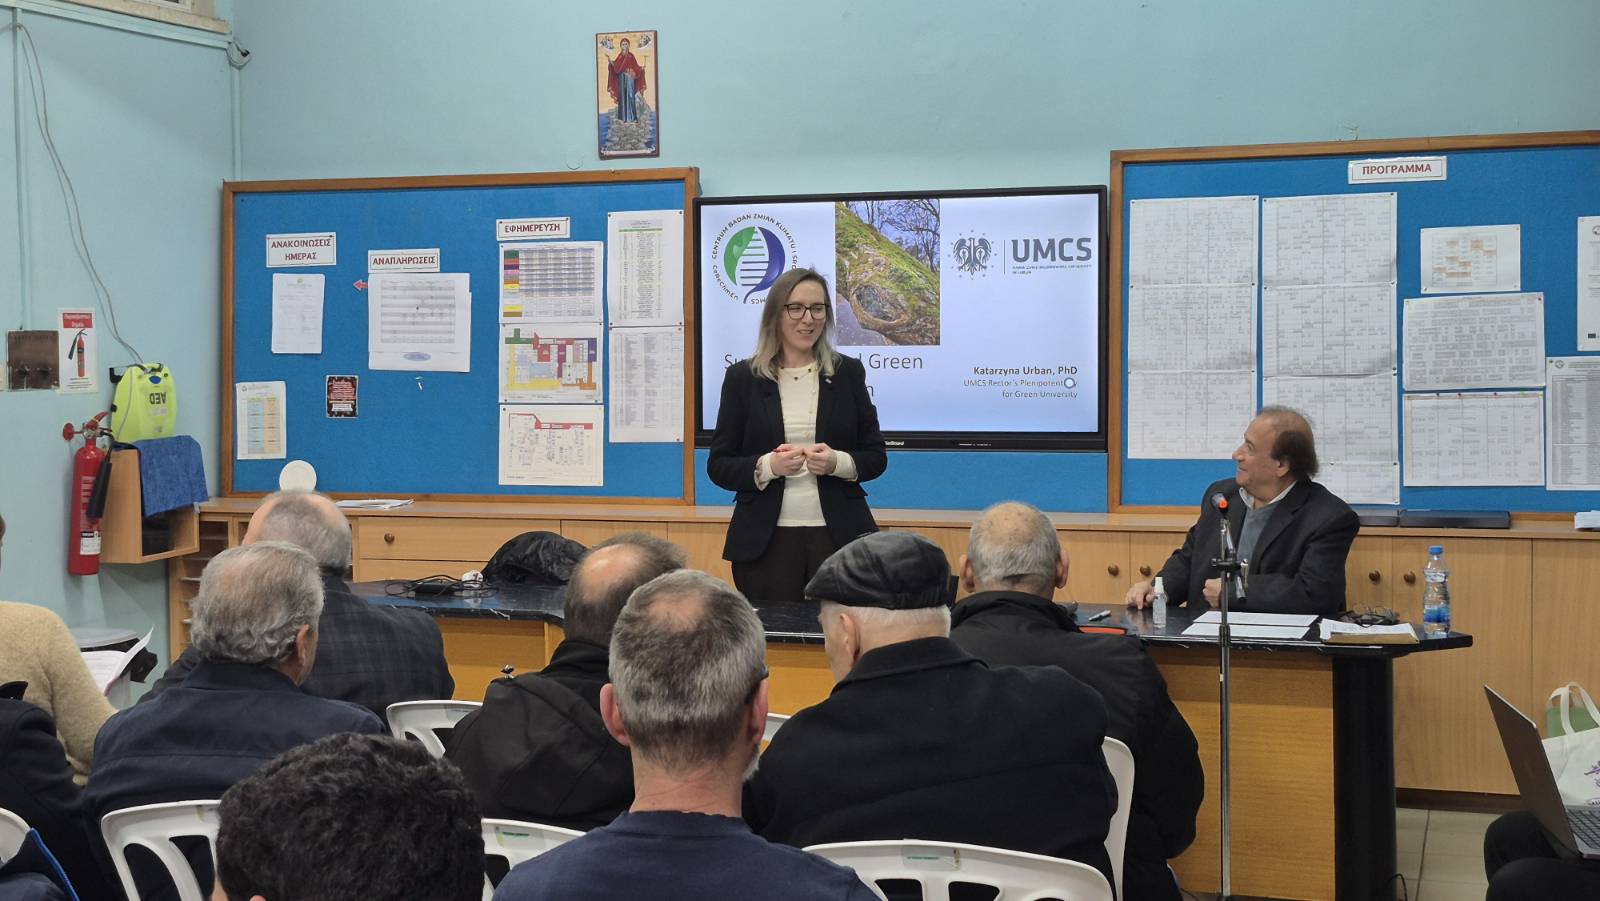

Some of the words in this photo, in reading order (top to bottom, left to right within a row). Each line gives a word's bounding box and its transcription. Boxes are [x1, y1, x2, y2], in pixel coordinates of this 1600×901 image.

[1362, 164, 1432, 175] ΠΡΟΓΡΑΜΜΑ
[504, 223, 560, 233] ΕΦΗΜΕΡΕΥΣΗ
[712, 226, 729, 259] CENTRUM
[753, 213, 775, 224] ZMIAN
[775, 222, 796, 249] KLIMATU
[271, 238, 332, 249] ΑΝΑΚΟΙΝΩΣΕΙΣ
[1011, 238, 1092, 263] UMCS
[285, 252, 316, 261] ΗΜΕΡΑΣ
[372, 256, 436, 265] ΑΝΑΠΛΗΡΩΣΕΙΣ
[869, 353, 923, 370] Green
[973, 366, 1020, 376] Katarzyna
[1023, 366, 1055, 376] Urban,
[1058, 366, 1078, 375] PhD
[963, 379, 987, 387] UMCS
[149, 391, 167, 405] AED
[1002, 390, 1013, 398] for
[1015, 390, 1038, 398] Green
[1040, 390, 1078, 399] University
